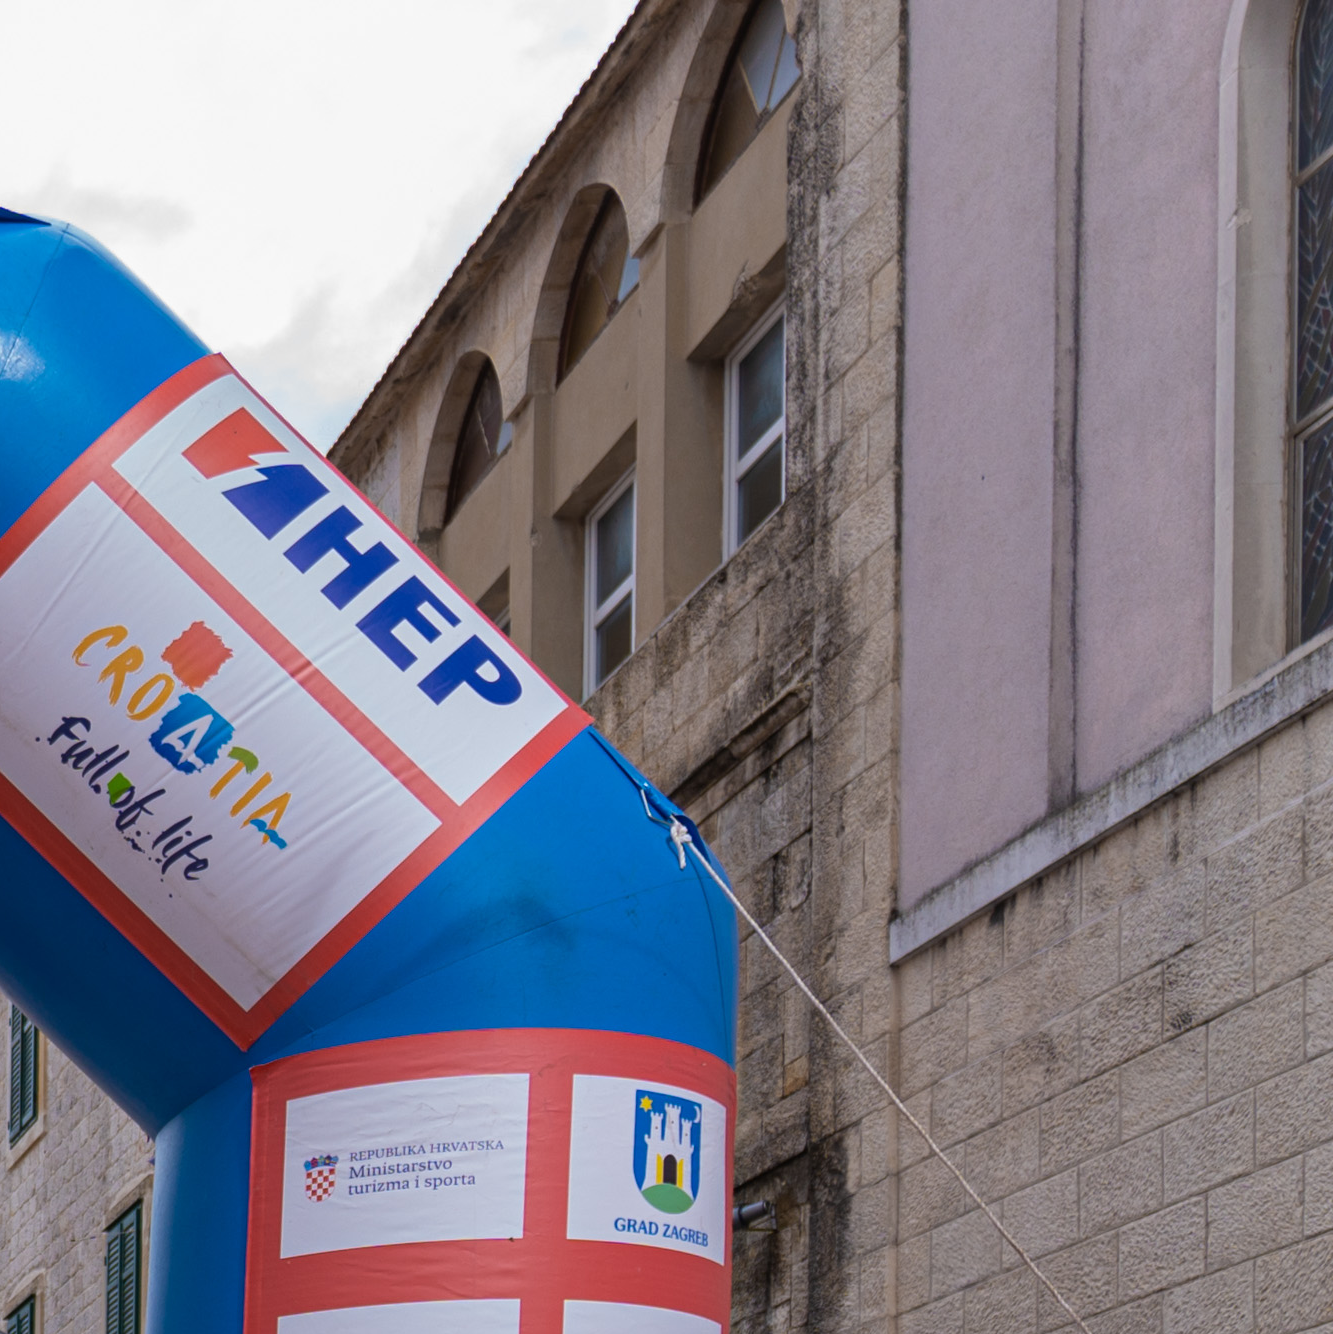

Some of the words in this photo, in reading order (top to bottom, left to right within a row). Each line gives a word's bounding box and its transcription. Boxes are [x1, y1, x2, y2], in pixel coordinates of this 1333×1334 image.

[283, 504, 523, 706] HEP
[71, 624, 292, 848] CROATIA
[47, 716, 131, 787] Full
[152, 815, 213, 880] life
[350, 1144, 427, 1162] REPUBLIKA
[430, 1140, 505, 1154] HRVATSKA
[349, 1159, 453, 1179] Ministarstvo
[348, 1179, 410, 1196] turizma
[414, 1175, 420, 1189] i
[424, 1174, 476, 1190] sporta
[614, 1217, 659, 1236] GRAD
[662, 1223, 709, 1248] ZAGREB
